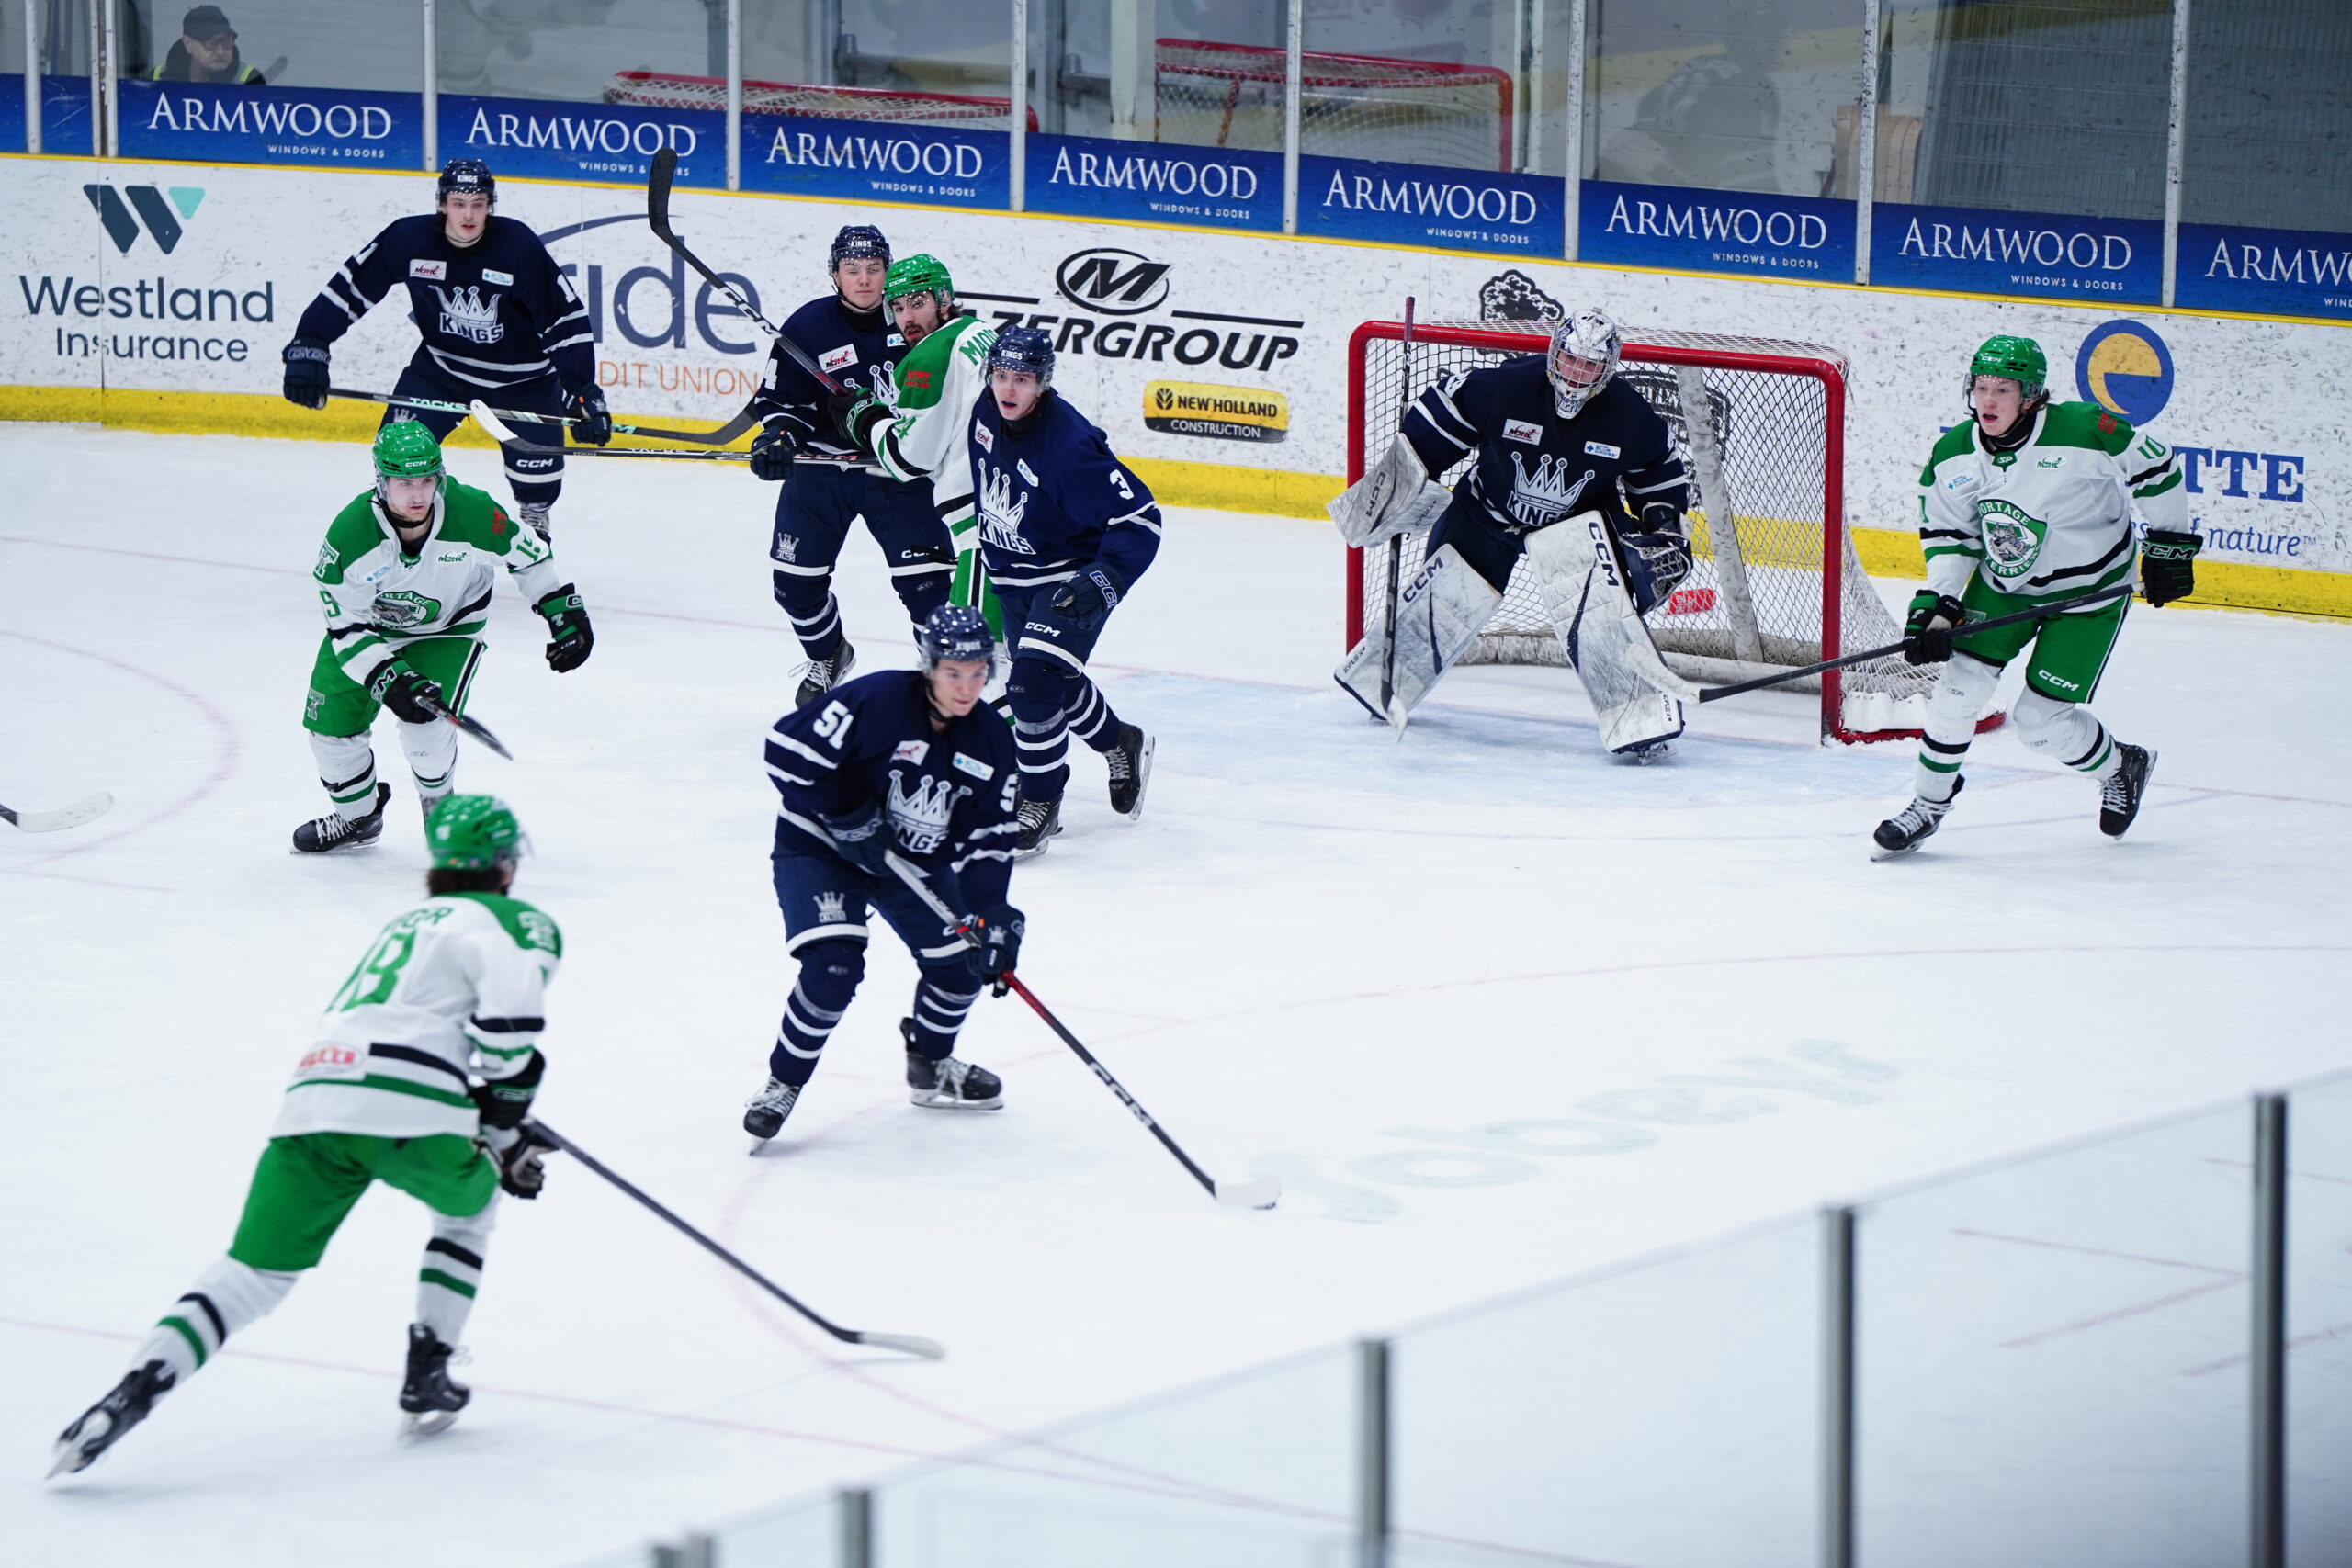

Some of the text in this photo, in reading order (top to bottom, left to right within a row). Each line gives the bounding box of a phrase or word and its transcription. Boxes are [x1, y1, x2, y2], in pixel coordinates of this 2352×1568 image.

[147, 92, 391, 139] ARMWOOD
[465, 107, 696, 157] ARMWOOD
[267, 145, 385, 158] WINDOWS & DOORS
[765, 126, 983, 177] ARMWOOD
[457, 175, 478, 184] KINGS
[579, 162, 634, 174] WINDOWS
[1048, 146, 1257, 199] ARMWOOD
[871, 181, 976, 197] WINDOWS & DOORS
[1322, 169, 1537, 224] ARMWOOD
[1150, 203, 1250, 219] WINDOWS & DOORS
[1604, 194, 1826, 249] ARMWOOD
[851, 240, 872, 248] KINGS
[1426, 228, 1530, 244] WINDOWS & DOORS
[1898, 217, 2132, 270] ARMWOOD
[1713, 252, 1819, 269] WINDOWS & DOORS
[2205, 237, 2352, 286] ARMW
[19, 276, 274, 322] Westland
[2011, 275, 2123, 291] WINDOWS & DOORS
[440, 312, 503, 344] KINGS
[718, 286, 783, 340] CCM
[56, 327, 248, 362] Insurance
[1001, 350, 1023, 361] KINGS
[599, 361, 758, 396] DIT UNION
[410, 397, 466, 411] TACKS
[1178, 395, 1278, 418] NEW HOLLAND
[1170, 419, 1261, 439] CONSTRUCTION
[405, 460, 427, 468] CCM
[516, 458, 553, 468] CCM
[1110, 468, 1134, 500] 3
[1365, 471, 1386, 518] CCM
[978, 513, 1036, 555] KINGS
[776, 549, 796, 562] KINGS
[1589, 522, 1619, 587] CCM
[1402, 557, 1443, 603] CCM
[1025, 621, 1061, 637] CCM
[2038, 669, 2080, 692] CCM
[813, 700, 854, 750] 51
[1088, 1061, 1154, 1129] CCM
